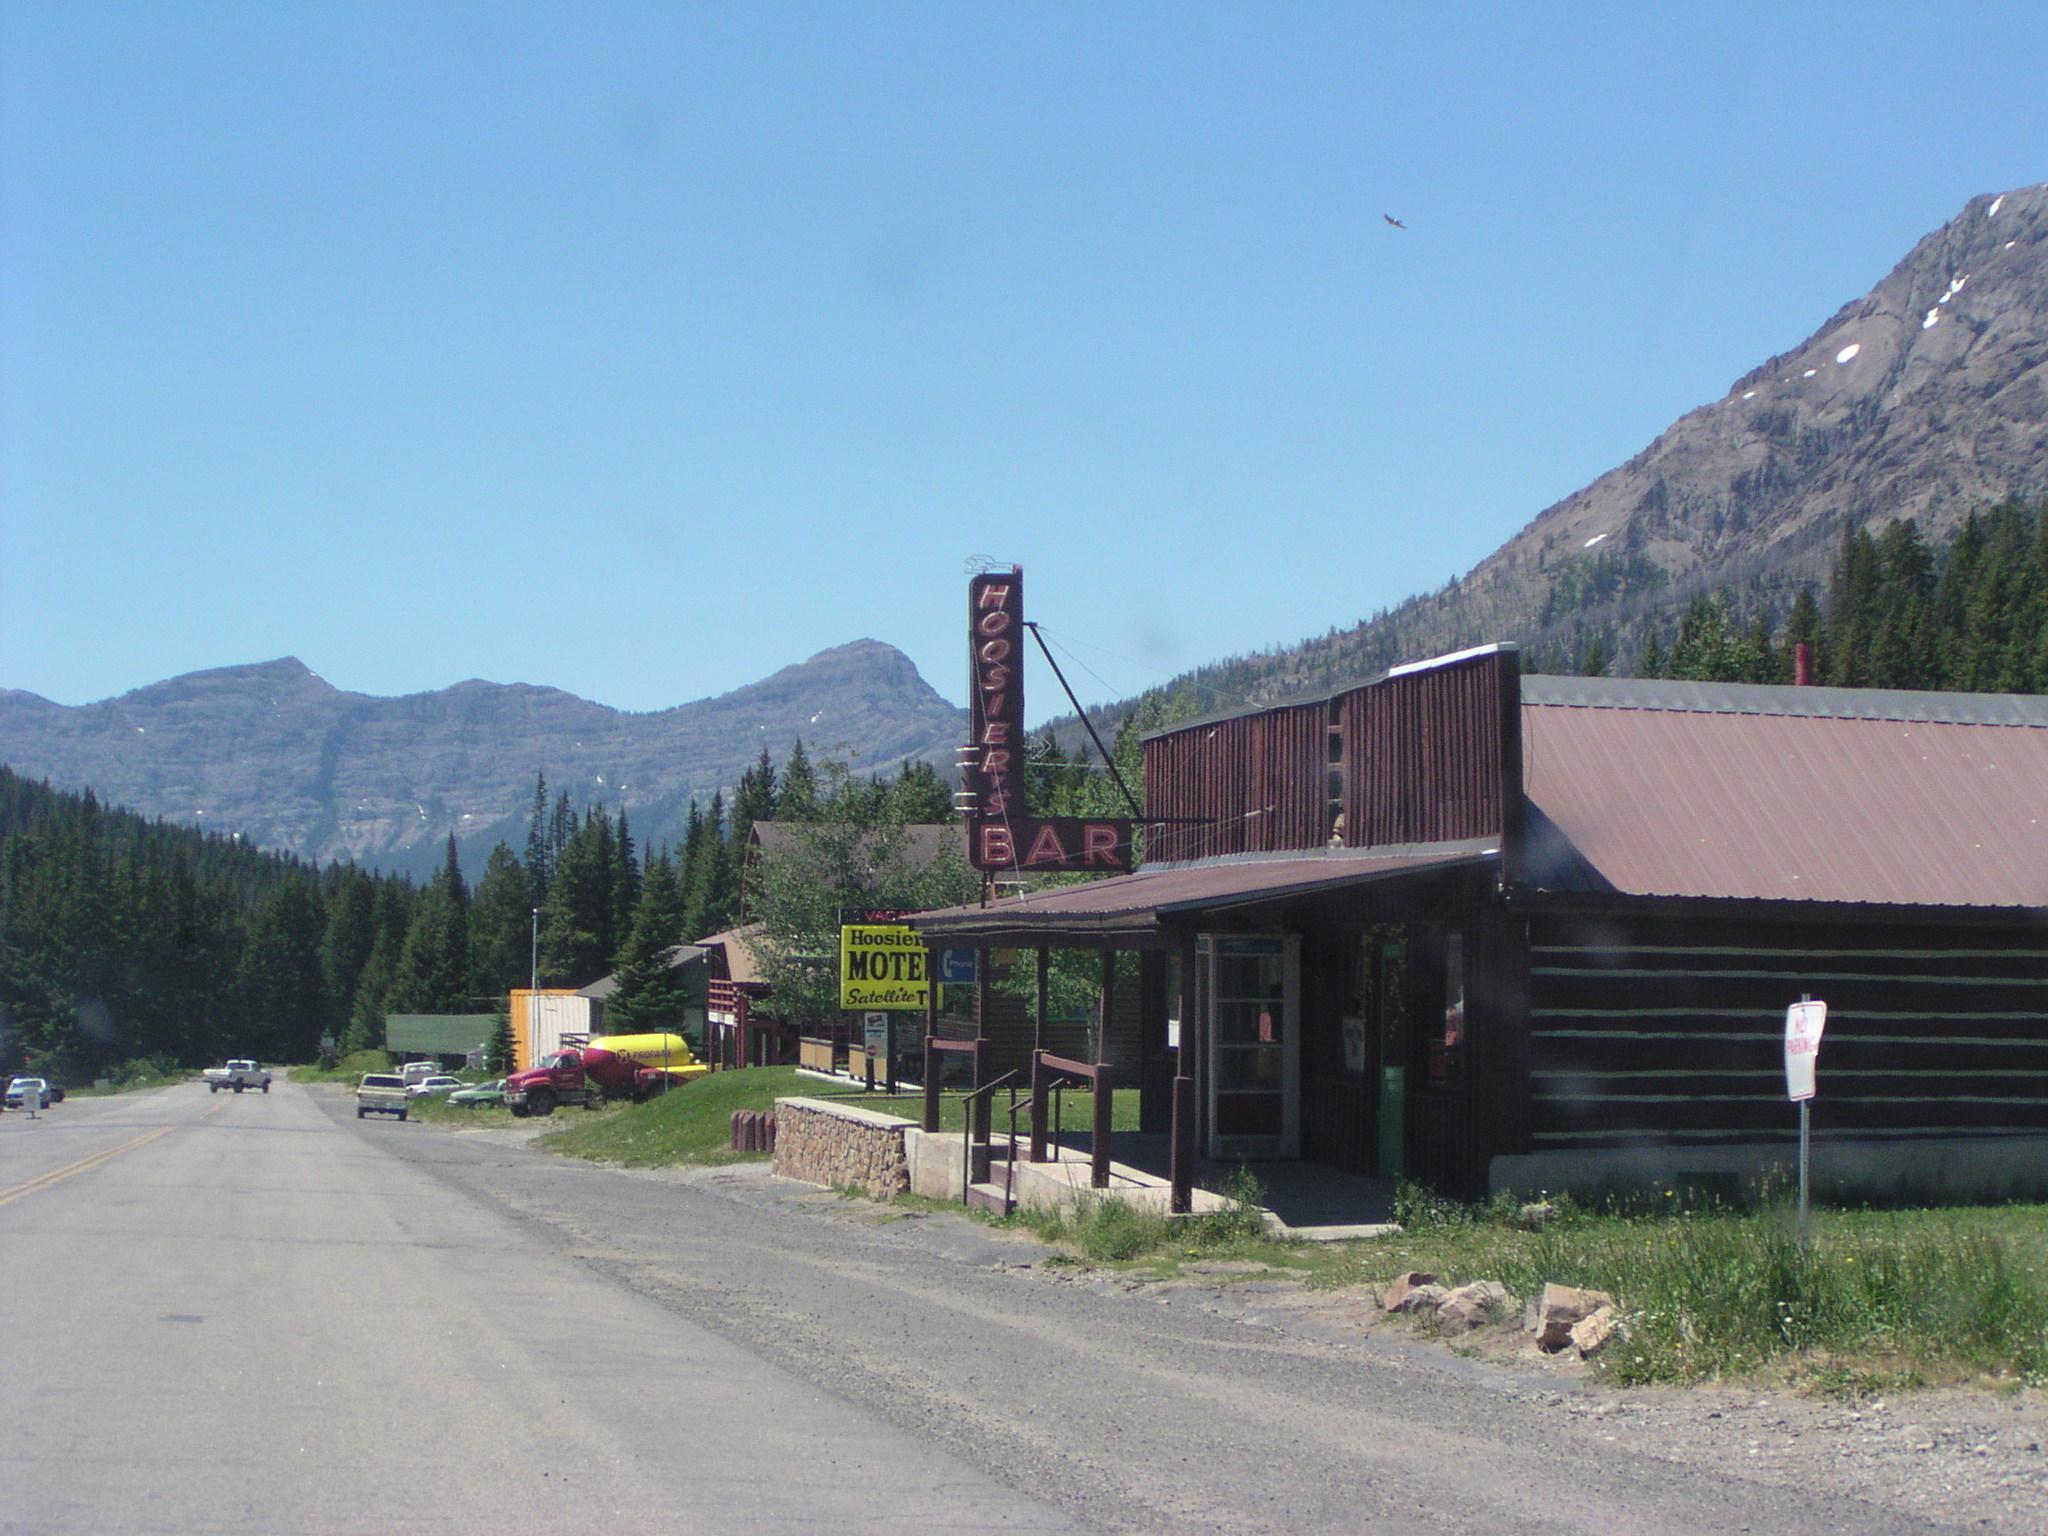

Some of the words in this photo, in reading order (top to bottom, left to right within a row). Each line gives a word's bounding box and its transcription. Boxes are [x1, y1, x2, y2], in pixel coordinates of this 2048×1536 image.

[982, 825, 1120, 865] BAR
[850, 930, 922, 946] Hoosier
[846, 986, 914, 1005] Satellite
[916, 990, 930, 1005] T
